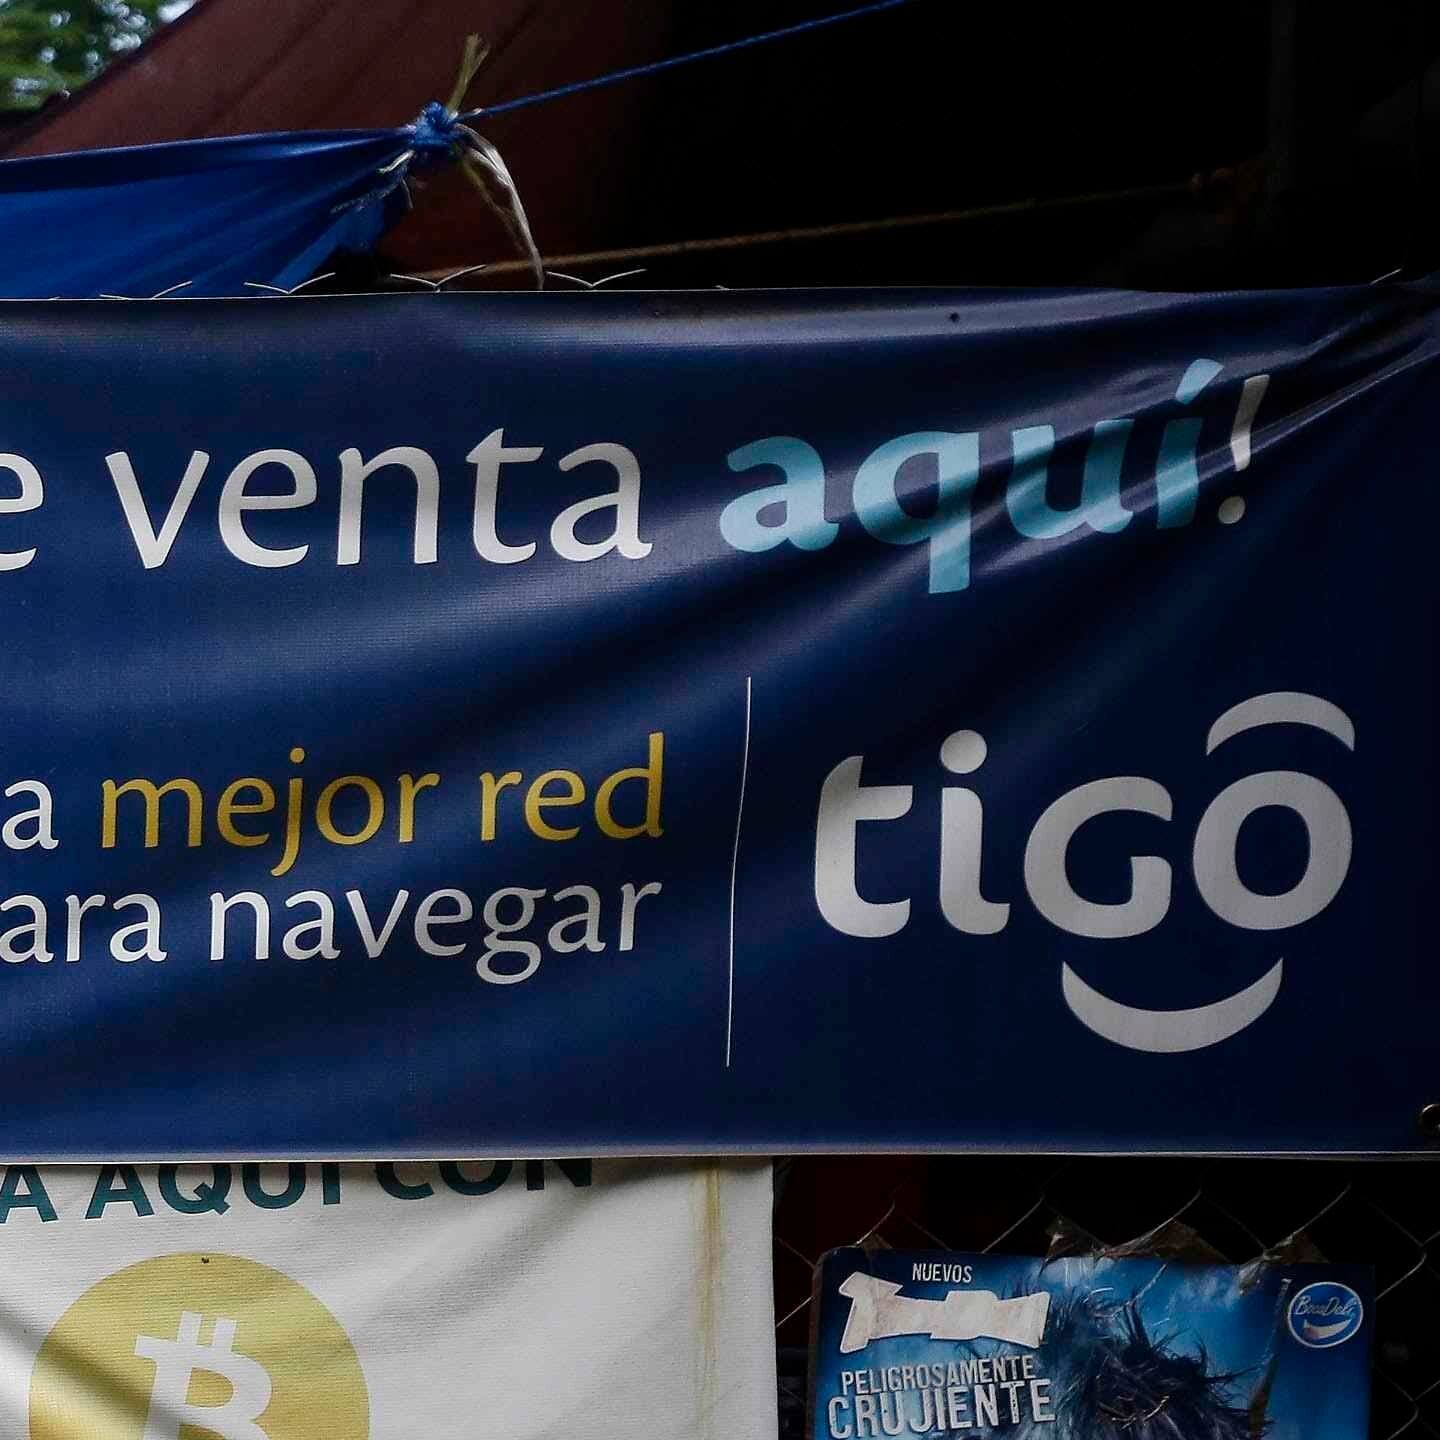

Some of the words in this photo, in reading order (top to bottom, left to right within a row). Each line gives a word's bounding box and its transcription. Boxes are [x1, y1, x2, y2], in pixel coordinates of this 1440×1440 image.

[107, 424, 653, 571] venta
[717, 356, 1271, 595] aquí!
[100, 747, 439, 879] mejor
[479, 732, 664, 840] red
[207, 875, 661, 985] navegar
[912, 1262, 973, 1284] NUEVOS
[827, 1378, 1057, 1440] CRUJIENTE
[841, 1354, 1036, 1395] PELIGROSAMENTE
